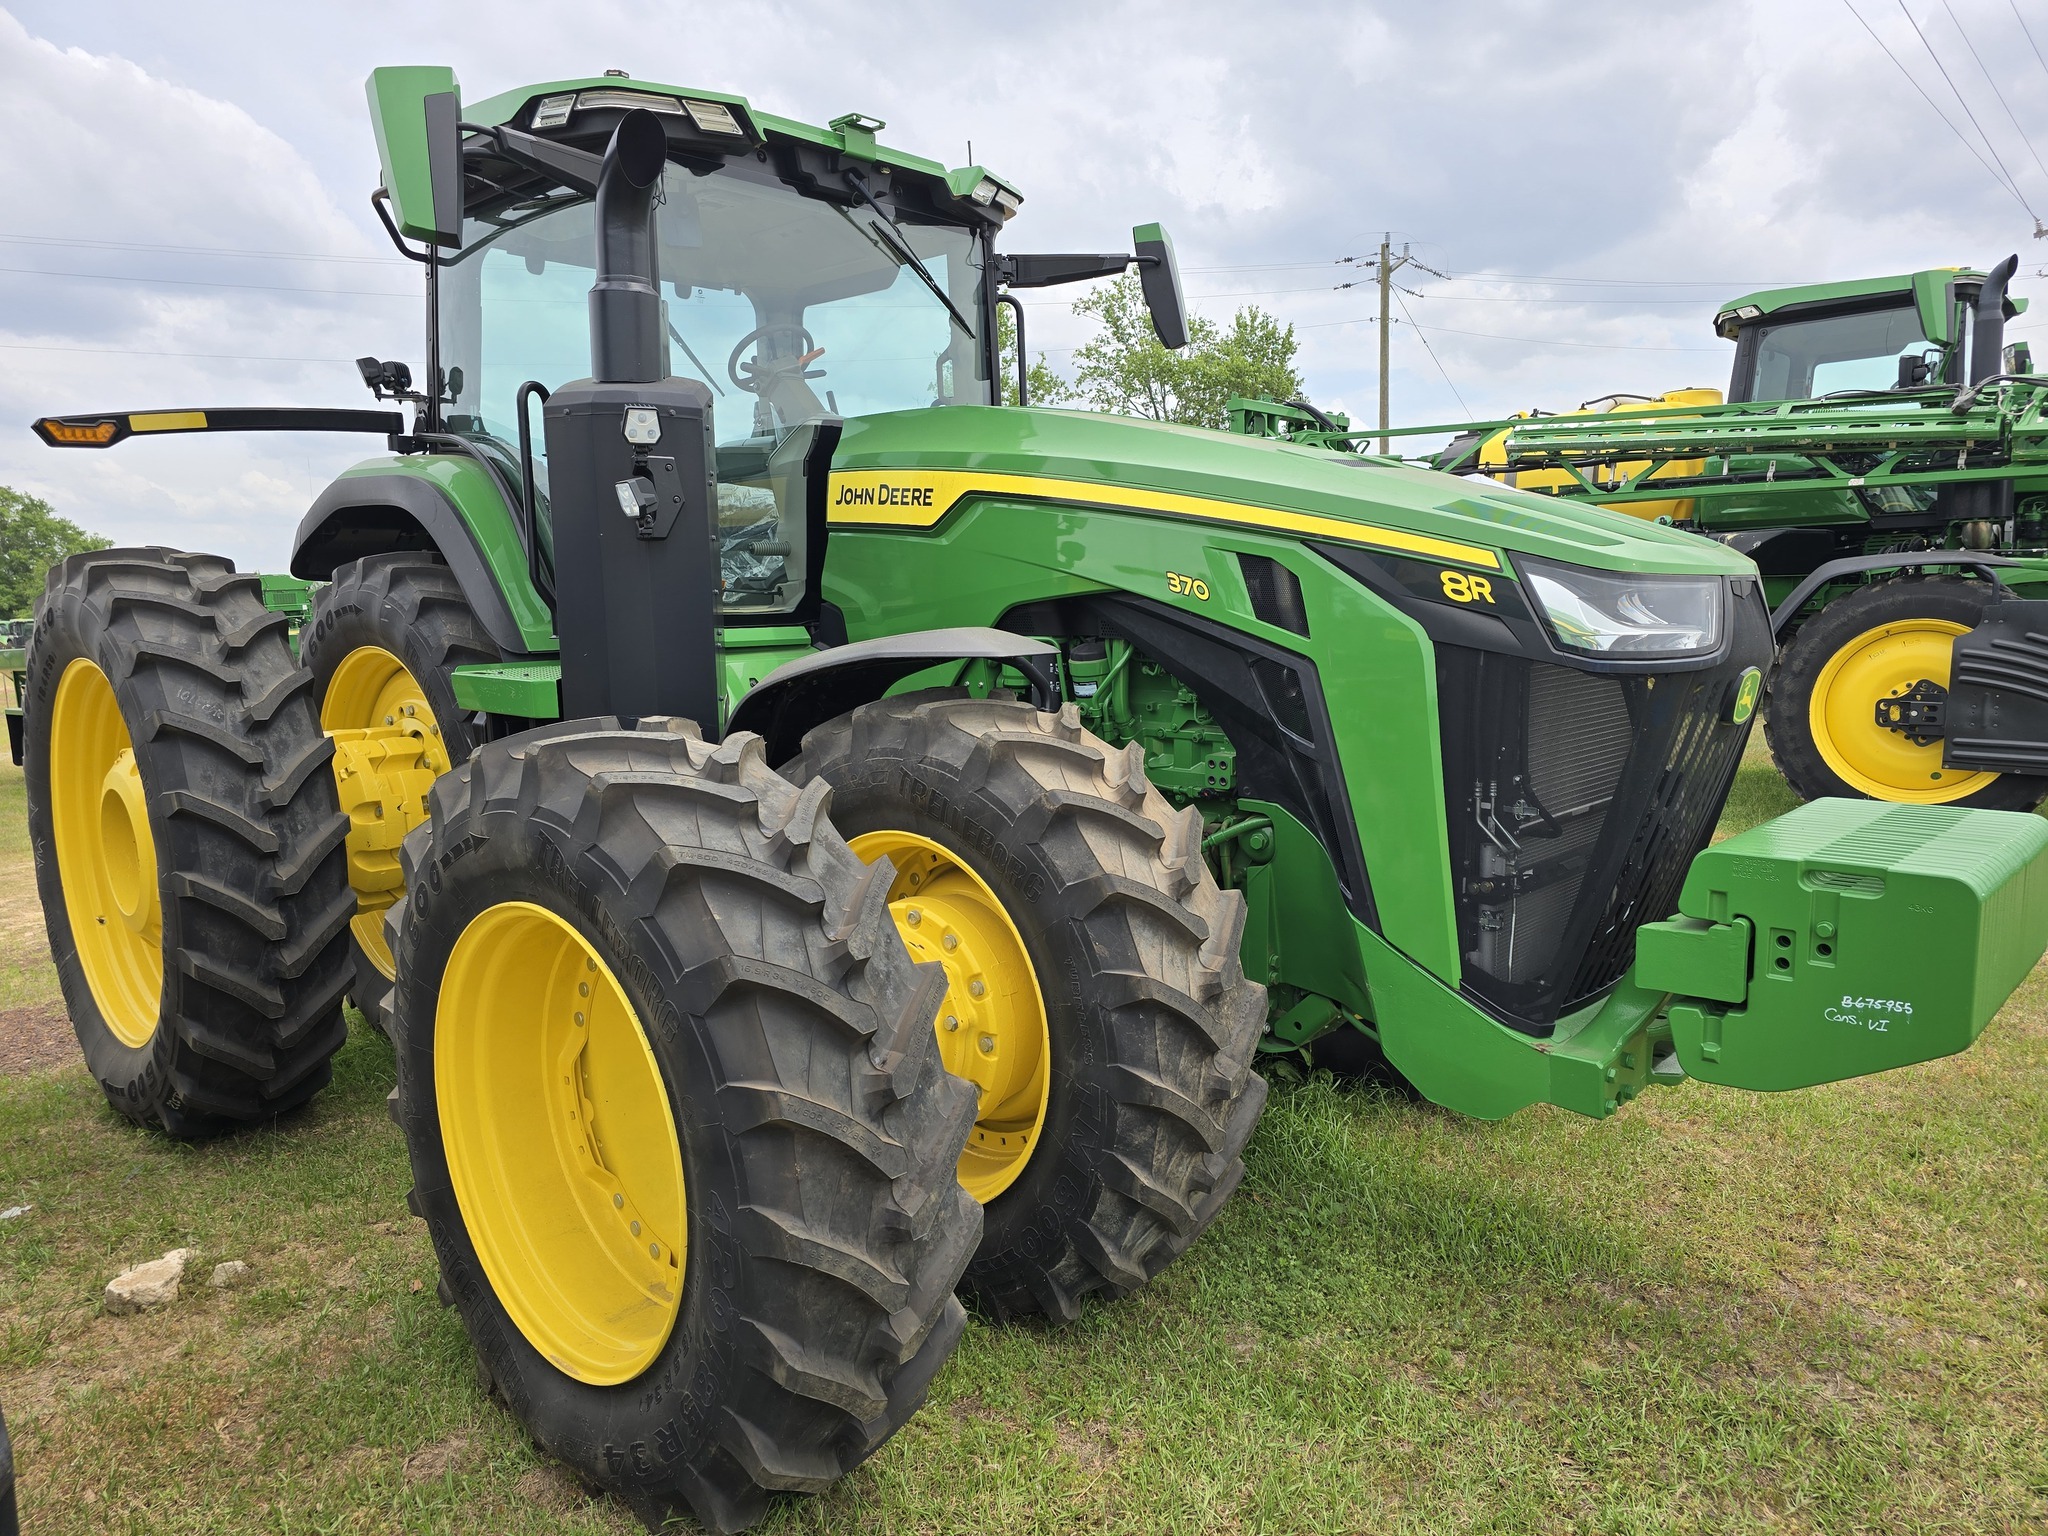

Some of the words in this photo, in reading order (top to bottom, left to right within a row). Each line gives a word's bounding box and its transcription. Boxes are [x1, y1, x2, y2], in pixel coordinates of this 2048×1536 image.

[835, 484, 875, 506] JOHN
[878, 484, 934, 507] DEERE
[1165, 571, 1210, 602] 370
[1440, 570, 1497, 604] 8R
[898, 764, 1047, 904] TRELLEBORG
[537, 828, 684, 1041] TRELLEBORG
